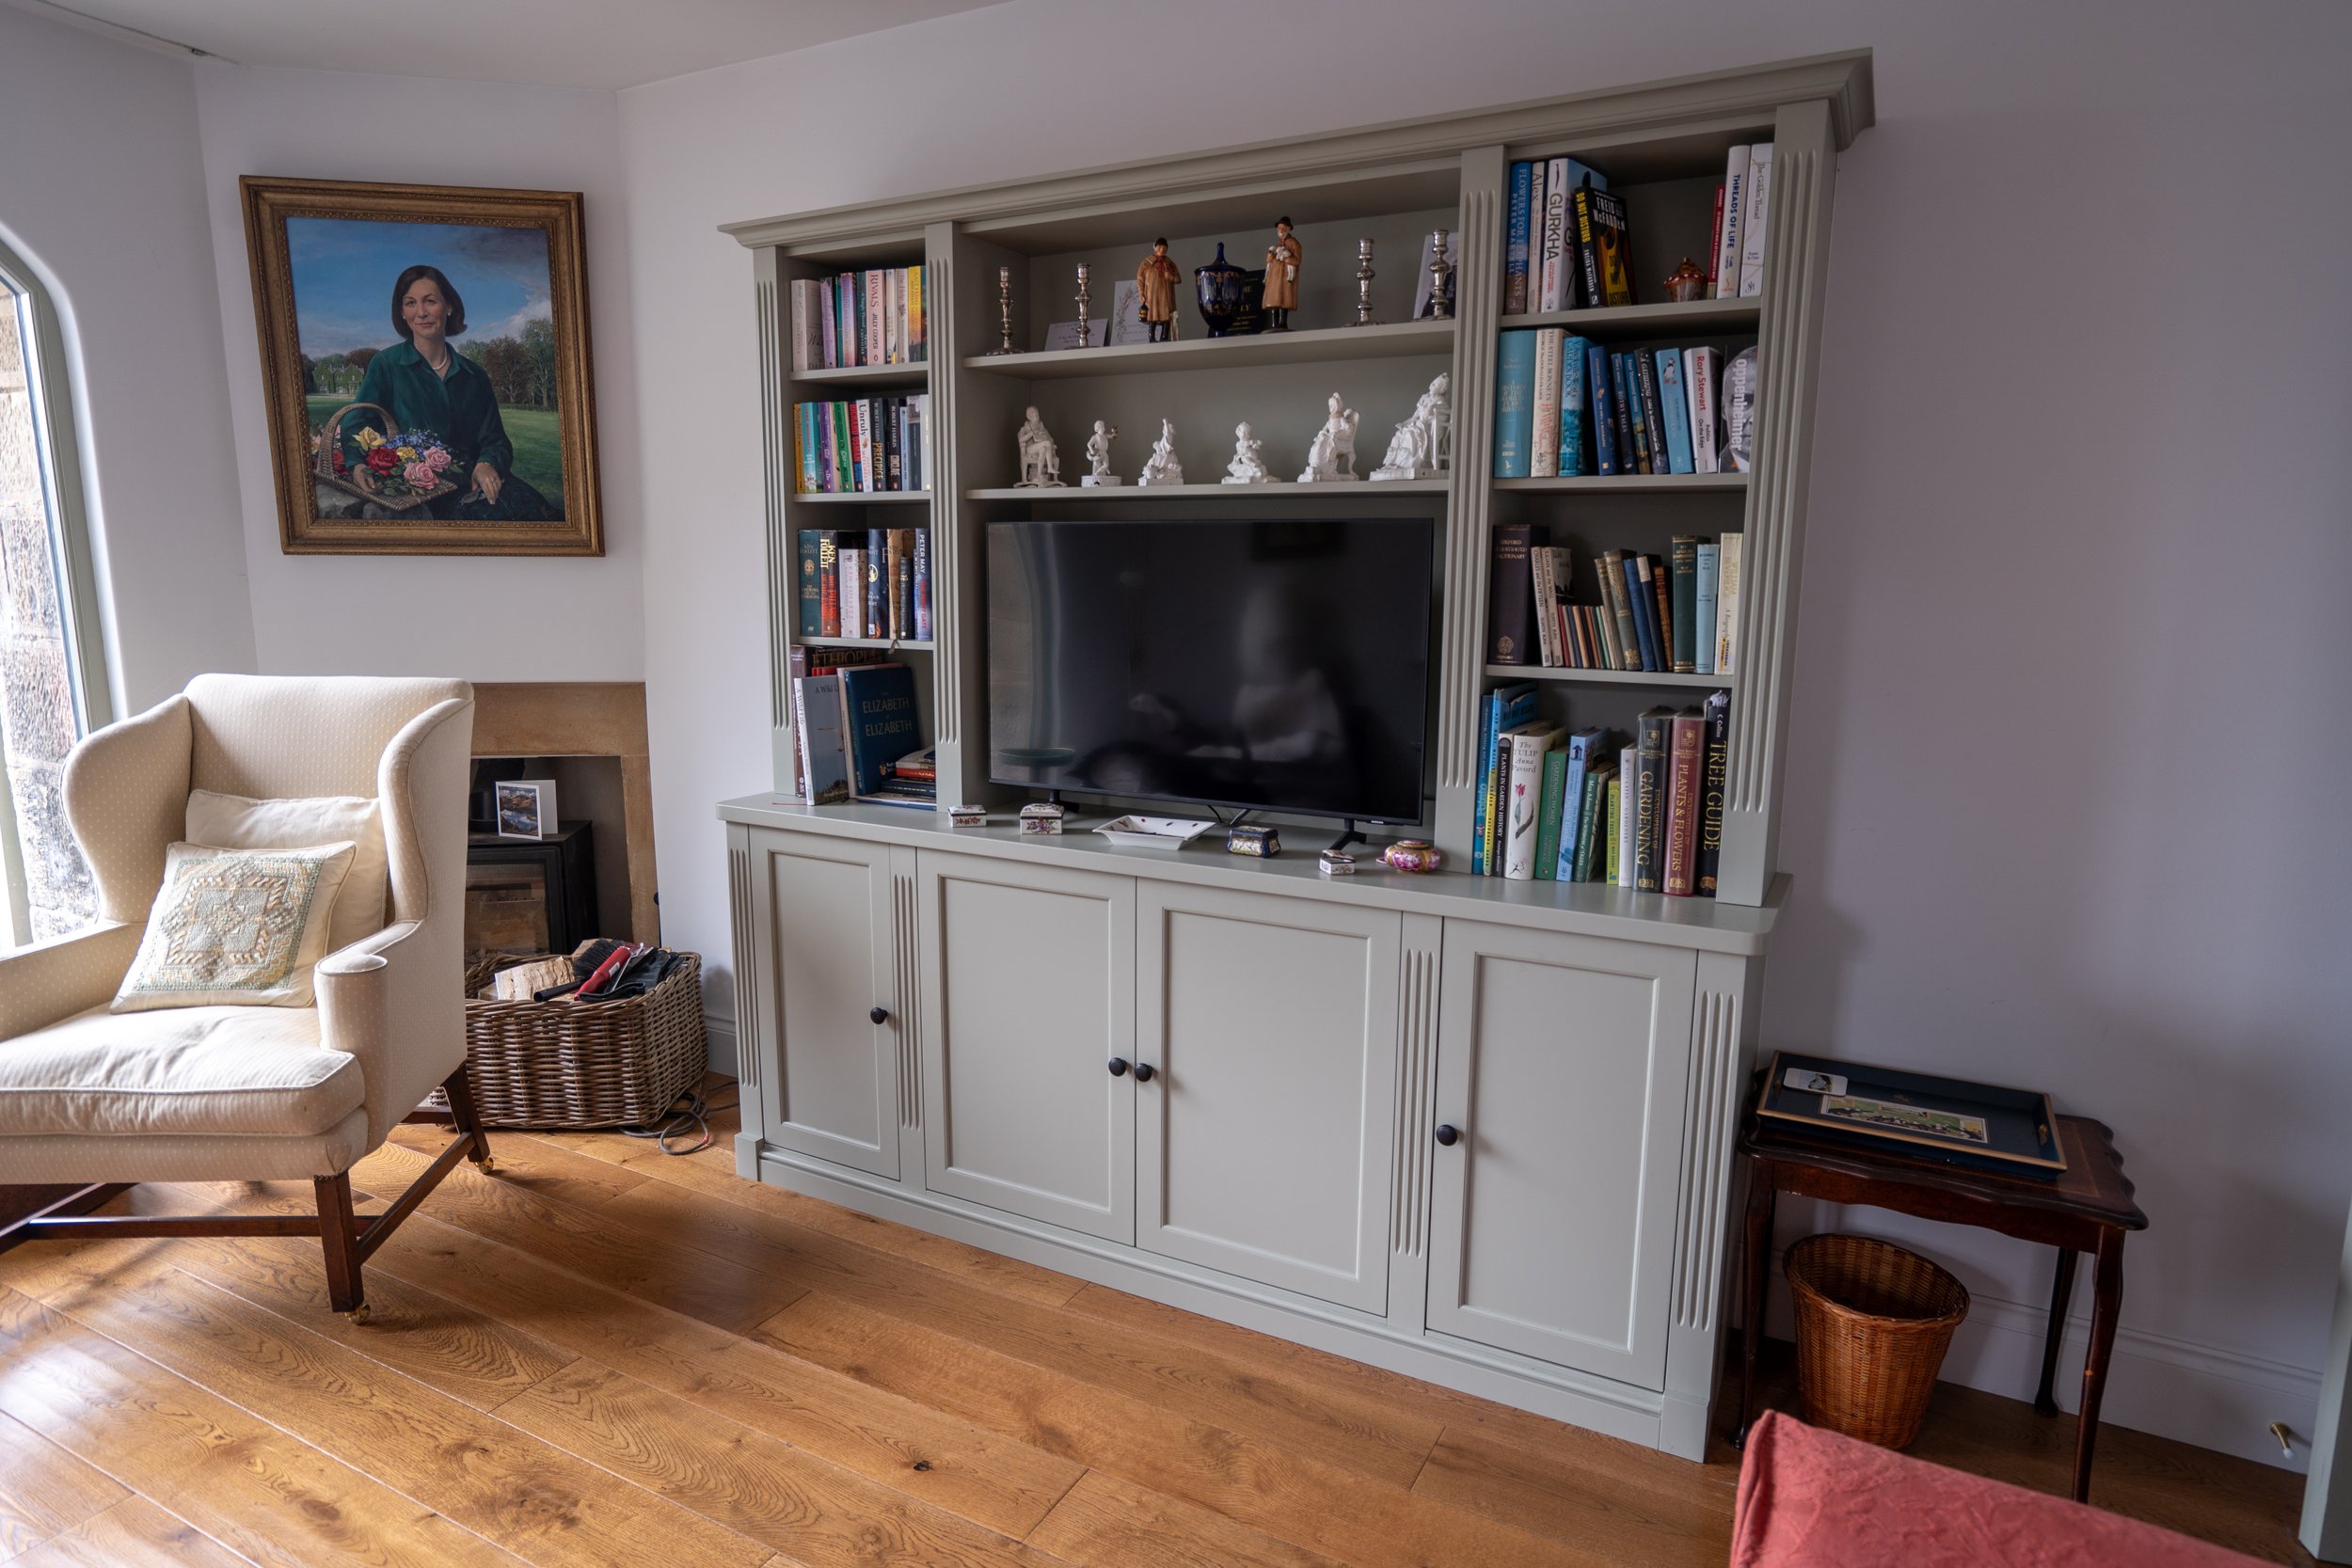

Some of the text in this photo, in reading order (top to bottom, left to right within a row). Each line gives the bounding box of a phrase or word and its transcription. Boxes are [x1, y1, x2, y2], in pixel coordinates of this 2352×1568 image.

[1531, 172, 1543, 202] Alex
[1755, 175, 1764, 198] Golden
[1546, 193, 1563, 261] GURKHA
[1576, 192, 1591, 244] DO NOT DISTURB
[1726, 174, 1740, 249] THREADS OF LIFE
[1514, 168, 1527, 296] FLOWERS FOR ELEPHANTS
[870, 274, 880, 308] RIVALS
[1641, 363, 1652, 397] GATHERING
[1695, 356, 1707, 412] Rory Stewart
[858, 404, 868, 437] Unruly
[1730, 358, 1748, 451] oppenheimer
[850, 404, 862, 462] RICHARD OSMAN
[873, 442, 883, 481] PRECIPICE
[820, 538, 830, 570] FOLLETT
[828, 545, 836, 563] KEN
[1730, 561, 1740, 595] WILLIAM
[862, 698, 910, 714] ELIZABETH
[865, 720, 913, 737] ELIZABETH
[1499, 753, 1508, 777] PLANTS
[1498, 785, 1506, 811] GARDEN
[1549, 761, 1561, 826] GARDENING WOMEN
[1585, 792, 1594, 811] Adams
[1704, 740, 1726, 851] TREE GUIDE
[1497, 811, 1505, 837] HISTORY
[1562, 796, 1574, 846] English Garden
[1637, 770, 1655, 866] GARDENING
[1671, 764, 1690, 872] PLANTS & FLOWERS
